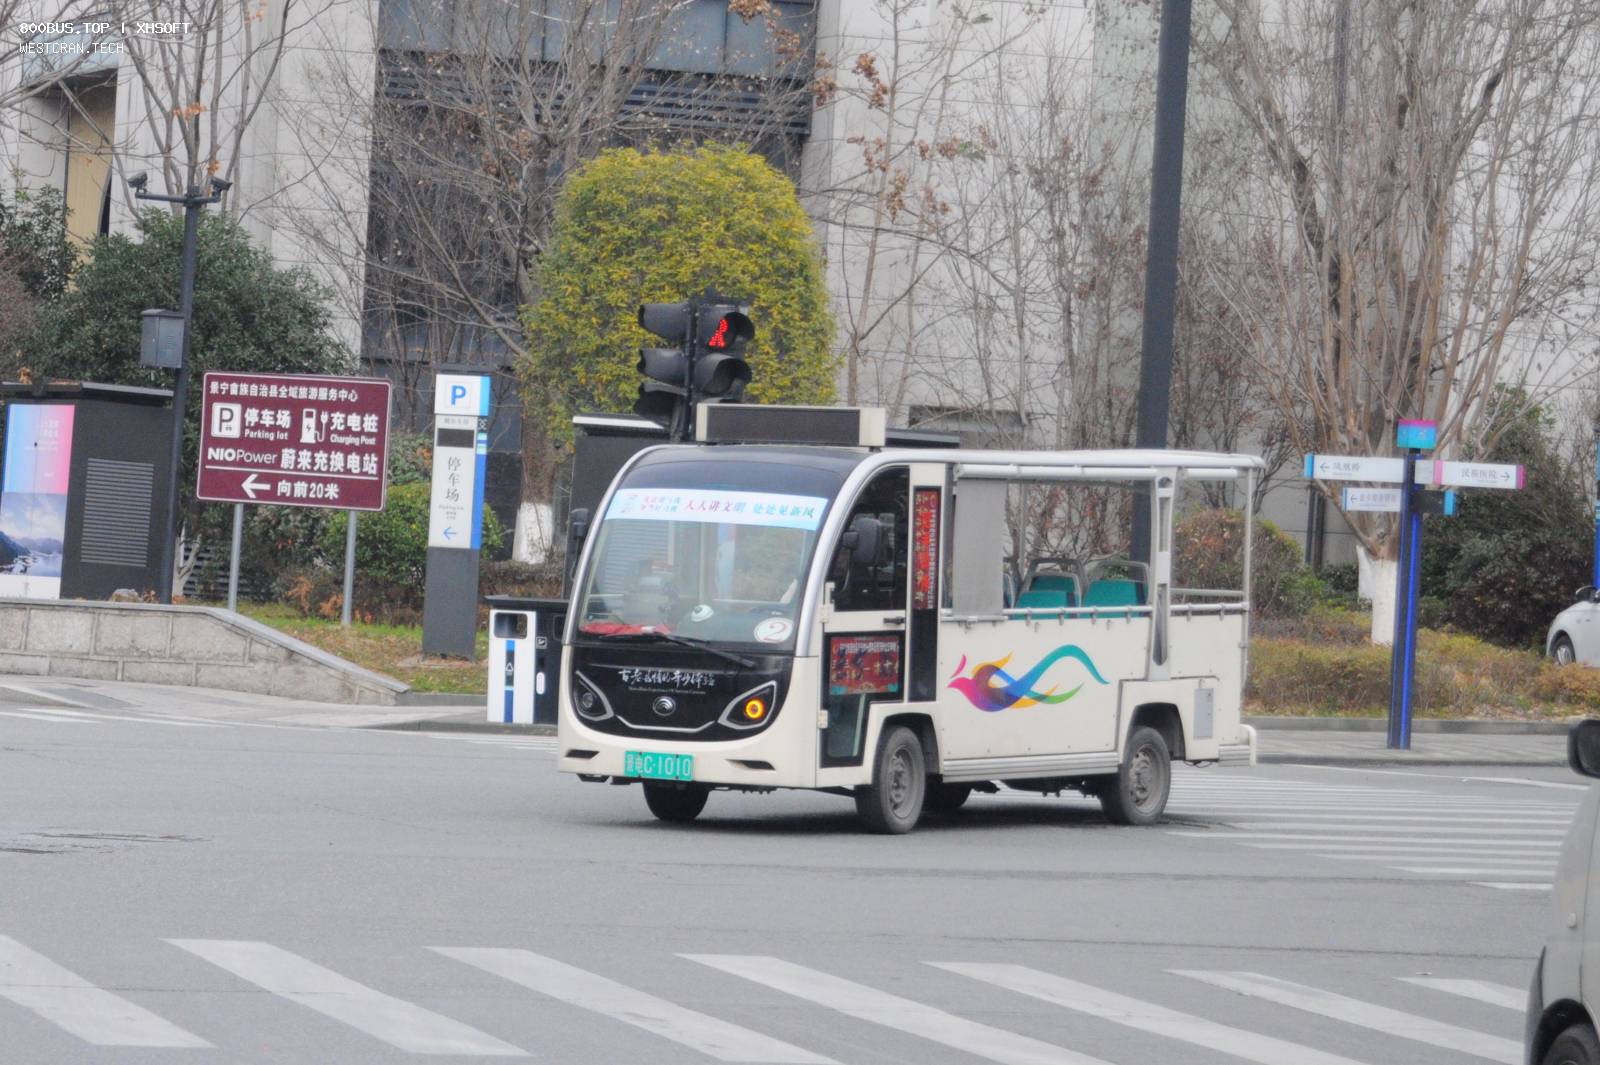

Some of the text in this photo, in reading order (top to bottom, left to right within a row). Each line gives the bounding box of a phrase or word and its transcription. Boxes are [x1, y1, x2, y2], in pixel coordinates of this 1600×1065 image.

[450, 384, 467, 406] P
[244, 407, 292, 429] 停车场
[329, 411, 380, 433] 充电桩
[243, 428, 275, 441] Parking
[329, 433, 377, 447] Charging Post
[280, 448, 379, 476] 蔚来充换电站
[276, 479, 340, 500] 向前20米
[445, 456, 463, 503] 停车场
[684, 498, 748, 514] 人人讲文明
[762, 621, 789, 643] 2
